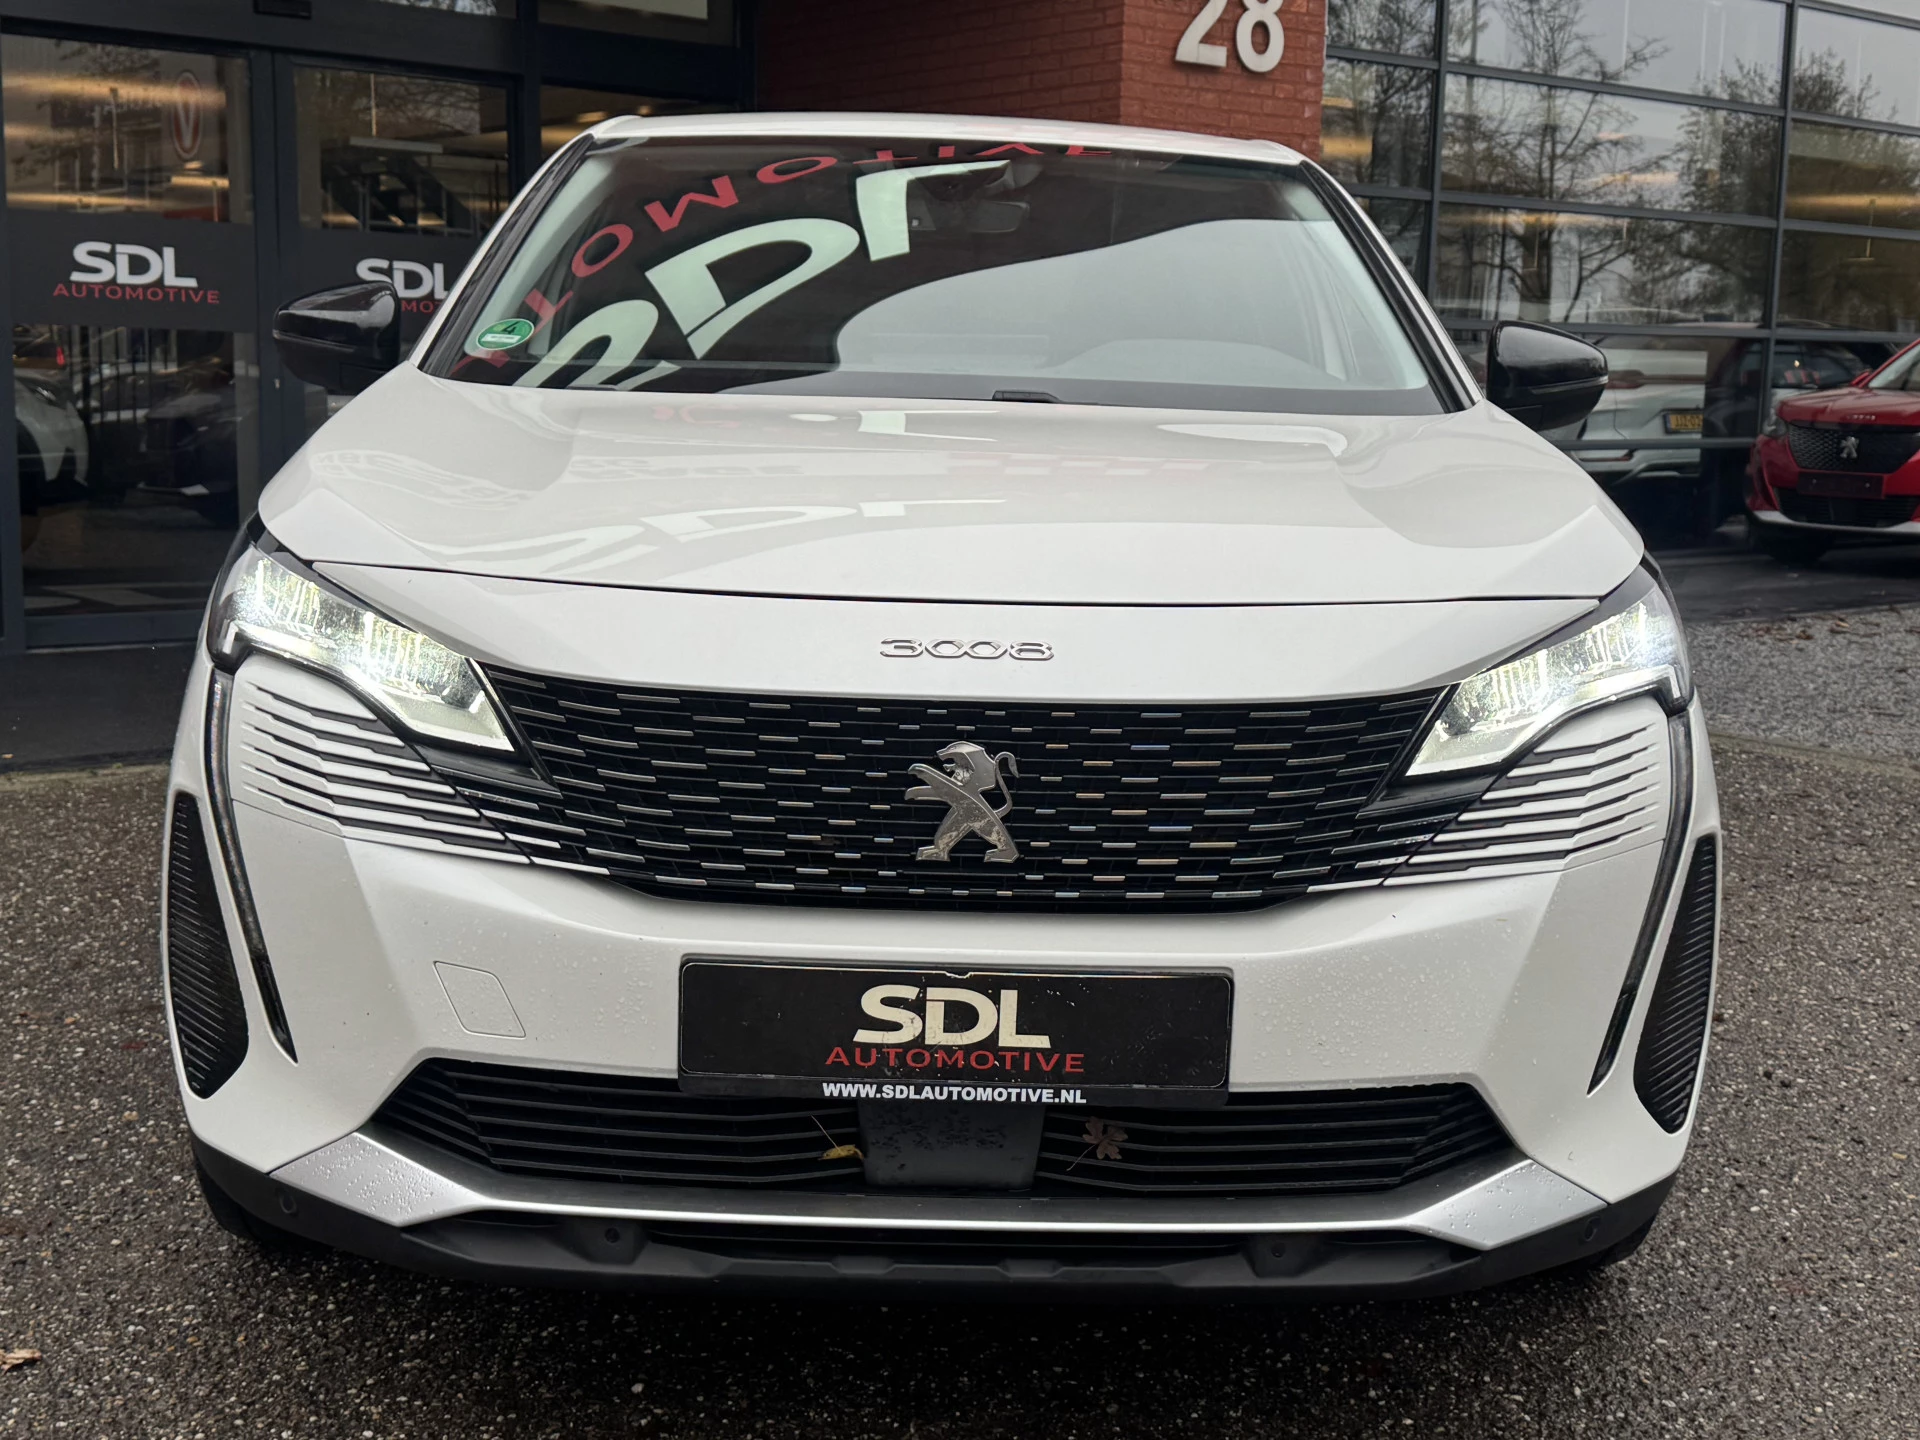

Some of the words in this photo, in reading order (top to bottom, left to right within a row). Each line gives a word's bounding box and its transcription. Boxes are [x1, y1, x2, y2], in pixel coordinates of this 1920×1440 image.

[1175, 0, 1285, 73] 28
[69, 241, 198, 288] SDL
[53, 283, 220, 305] AUTOMOTIVE
[501, 320, 521, 335] 4
[880, 638, 1055, 661] 3008
[853, 984, 1051, 1049] SDL
[825, 1046, 1085, 1073] AUTOMOTIVE
[823, 1082, 1087, 1104] WWW.SDLAUTOMOTIVE.NL
